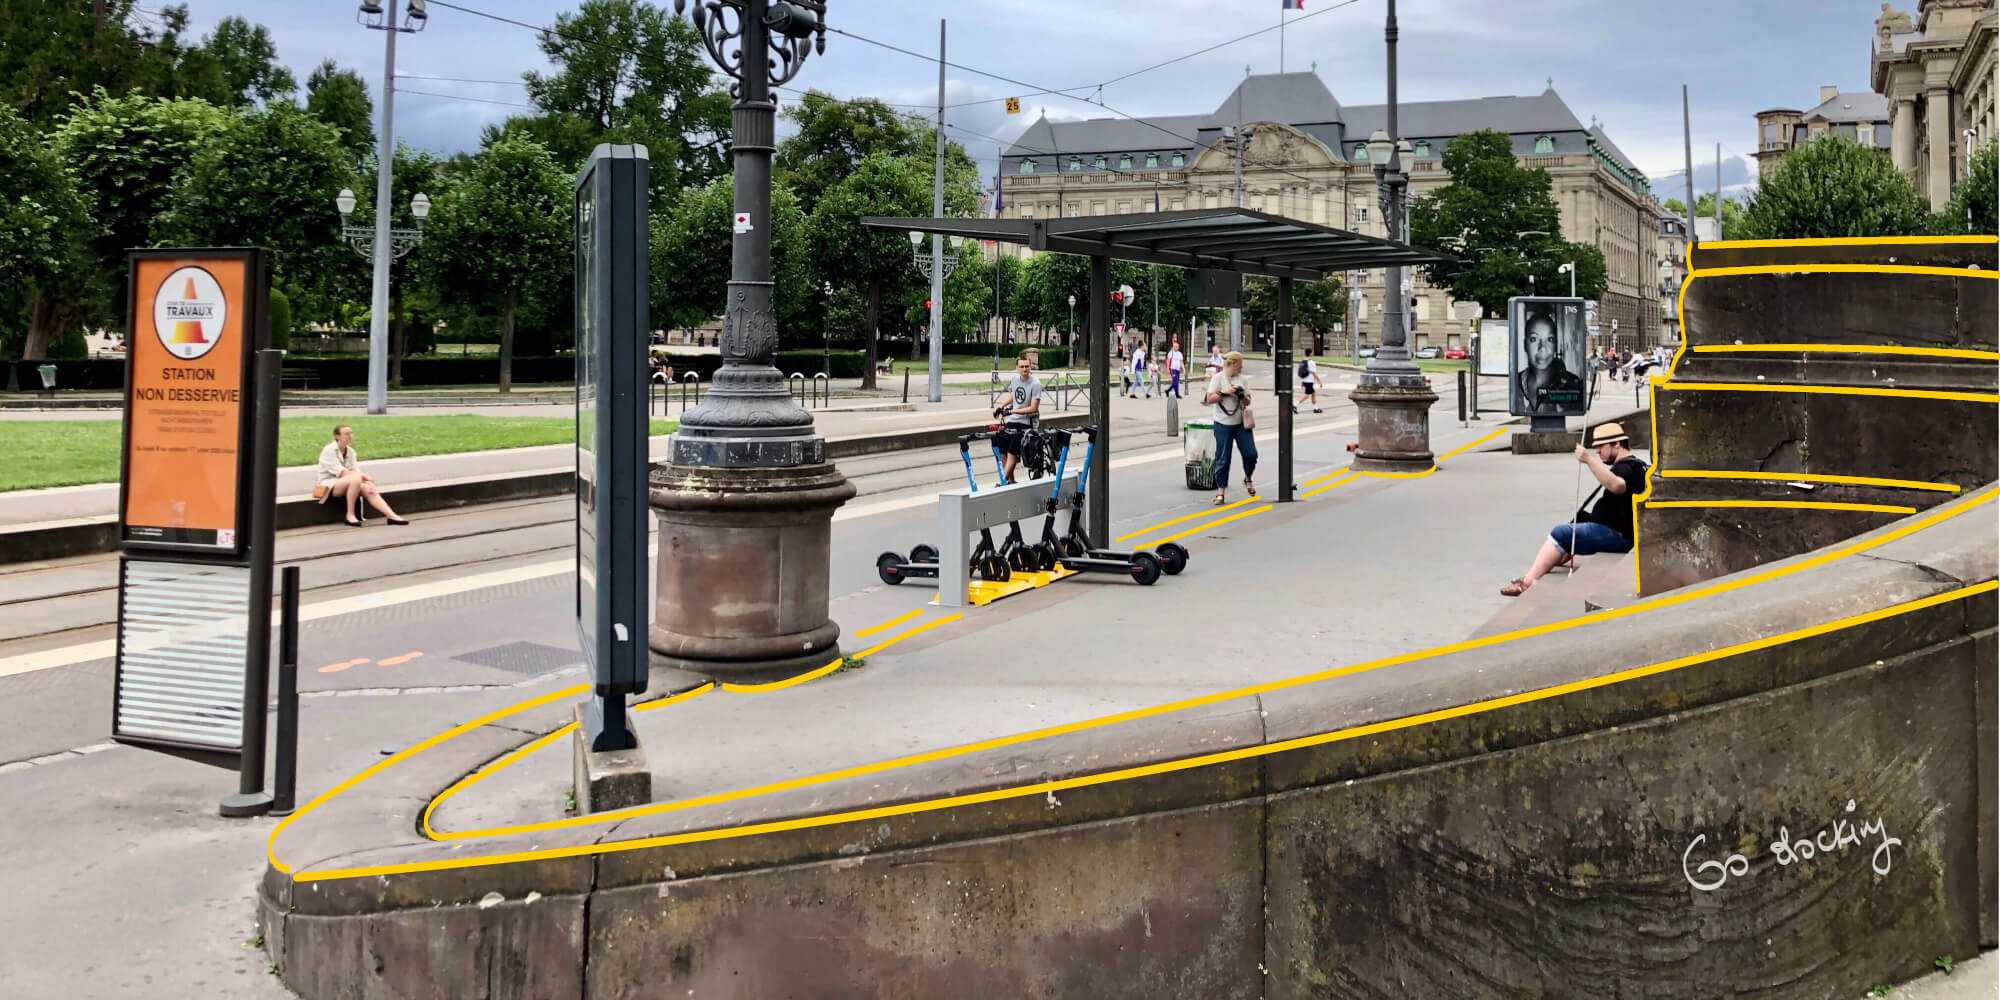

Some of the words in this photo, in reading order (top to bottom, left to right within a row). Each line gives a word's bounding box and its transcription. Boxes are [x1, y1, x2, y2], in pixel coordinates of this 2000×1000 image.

[1007, 102, 1019, 111] 25
[167, 306, 213, 316] TRAVAUX
[162, 368, 215, 380] STATION
[136, 388, 164, 400] NON
[168, 388, 239, 402] DESSERVIE
